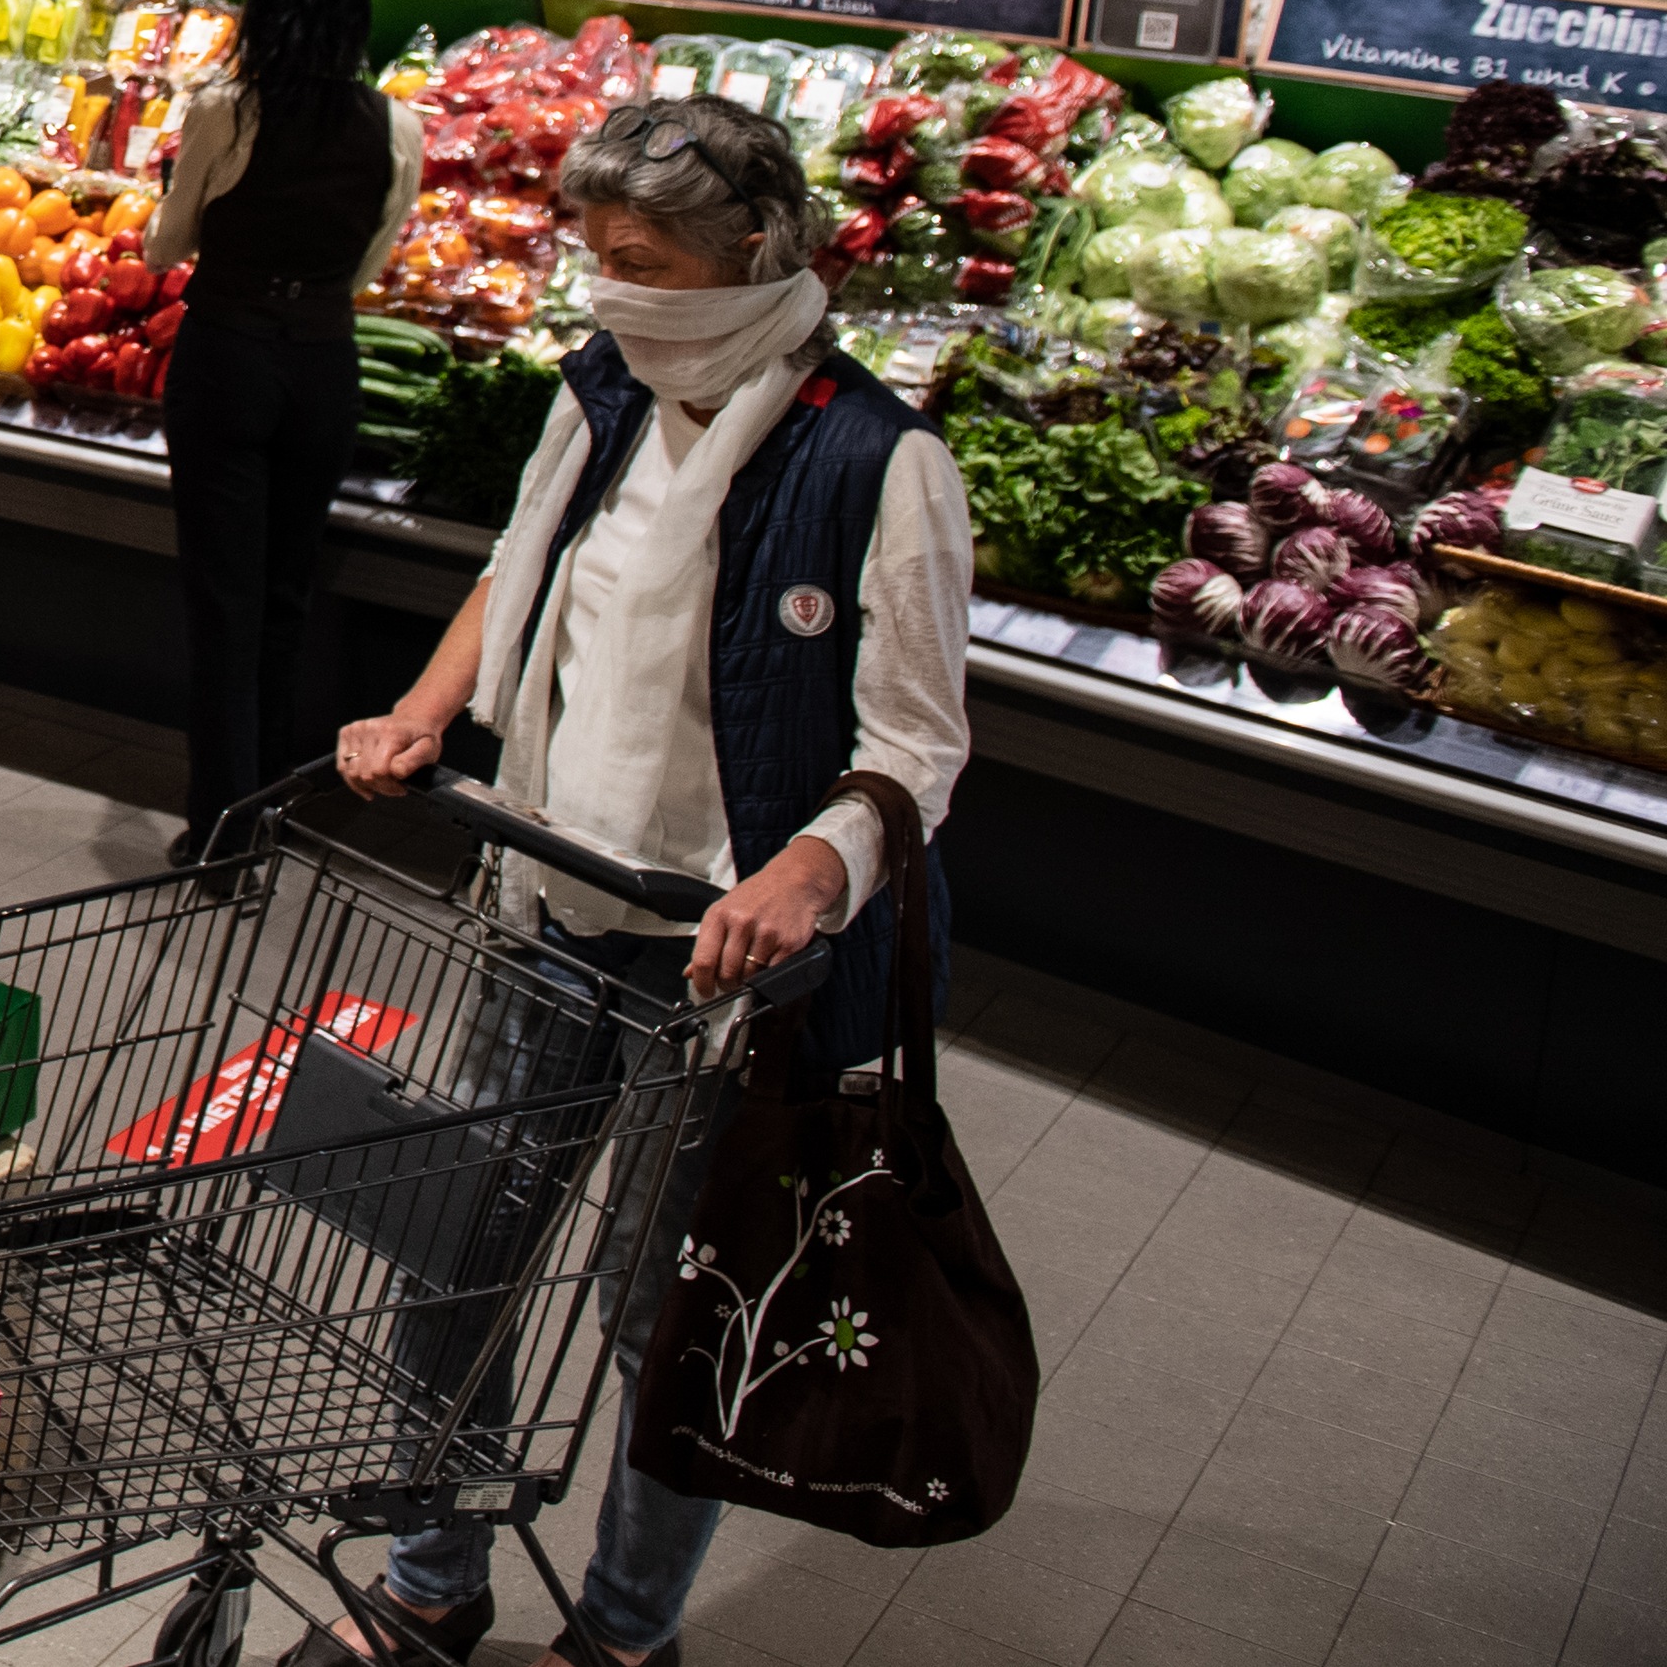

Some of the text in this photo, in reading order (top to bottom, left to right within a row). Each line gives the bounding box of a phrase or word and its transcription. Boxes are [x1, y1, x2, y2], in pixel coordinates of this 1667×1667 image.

[1322, 34, 1628, 95] Vitamine B1 und K
[1582, 505, 1624, 523] Sauce
